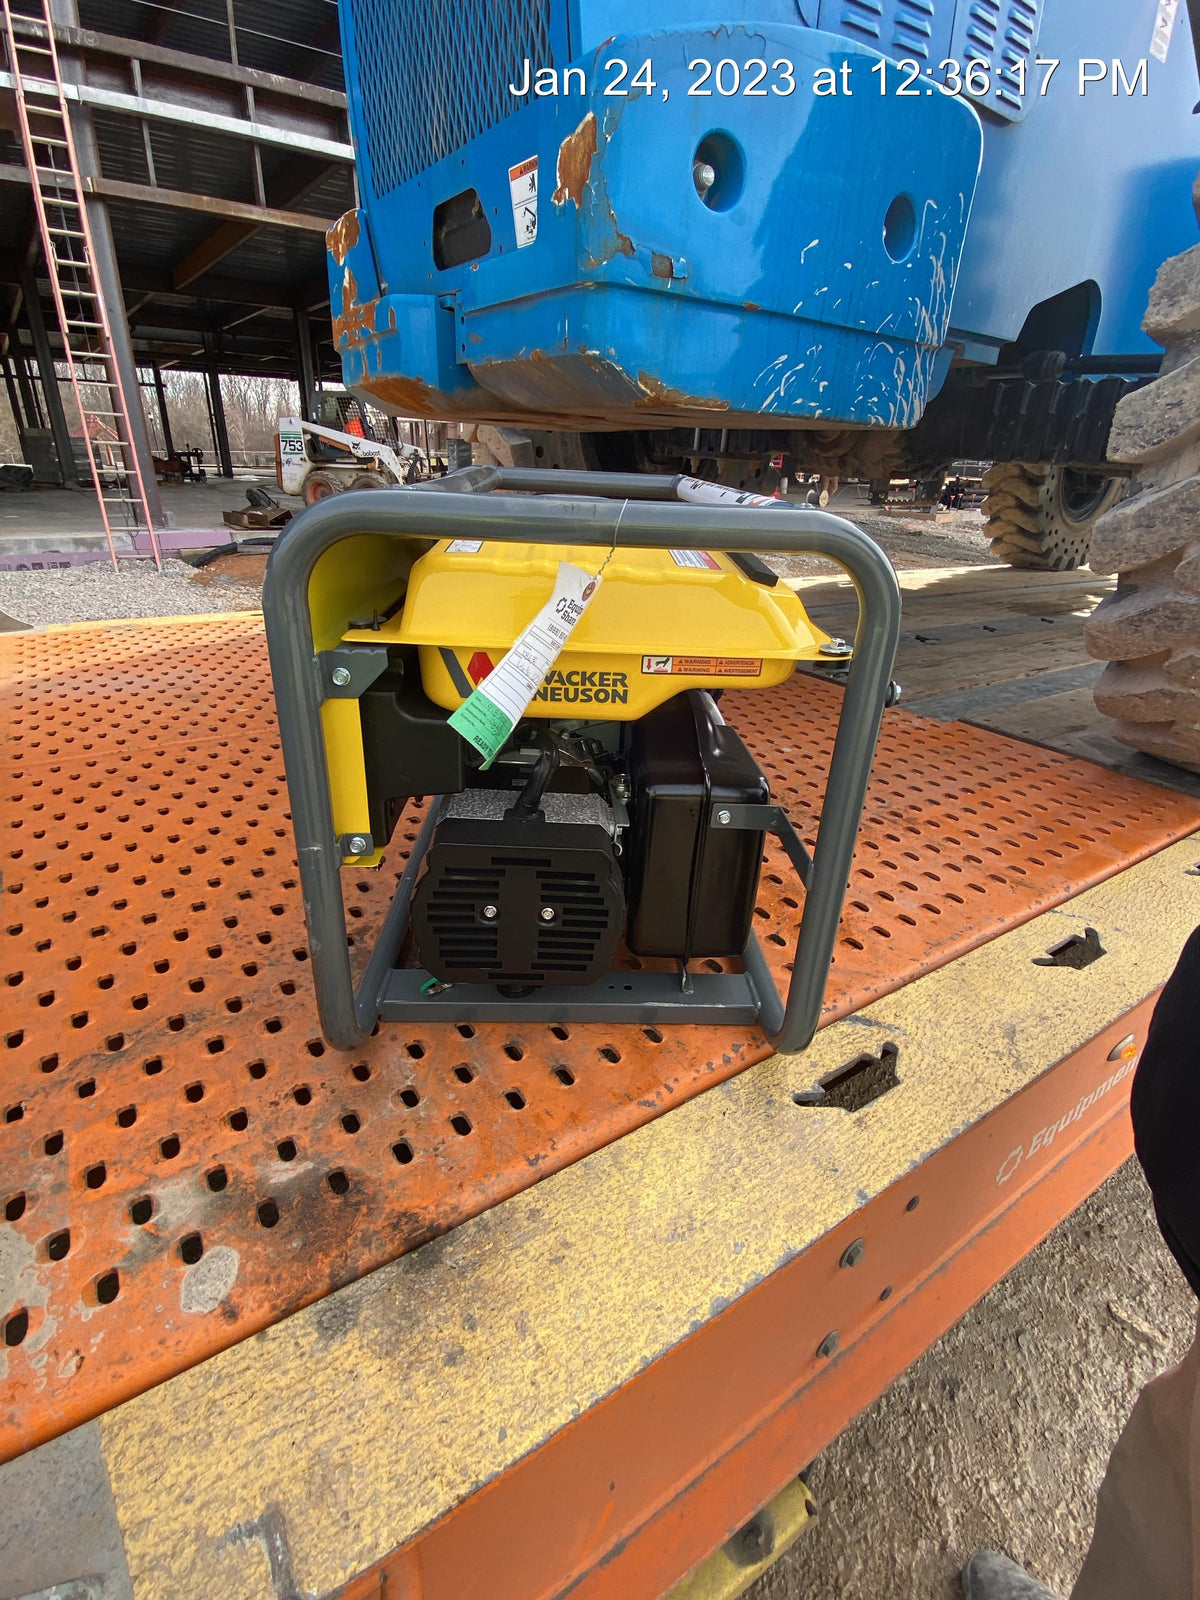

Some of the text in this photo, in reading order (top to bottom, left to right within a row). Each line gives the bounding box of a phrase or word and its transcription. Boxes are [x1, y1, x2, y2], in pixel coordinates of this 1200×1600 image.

[281, 439, 304, 452] 753
[566, 599, 585, 617] Equip
[532, 687, 628, 704] NEUSON
